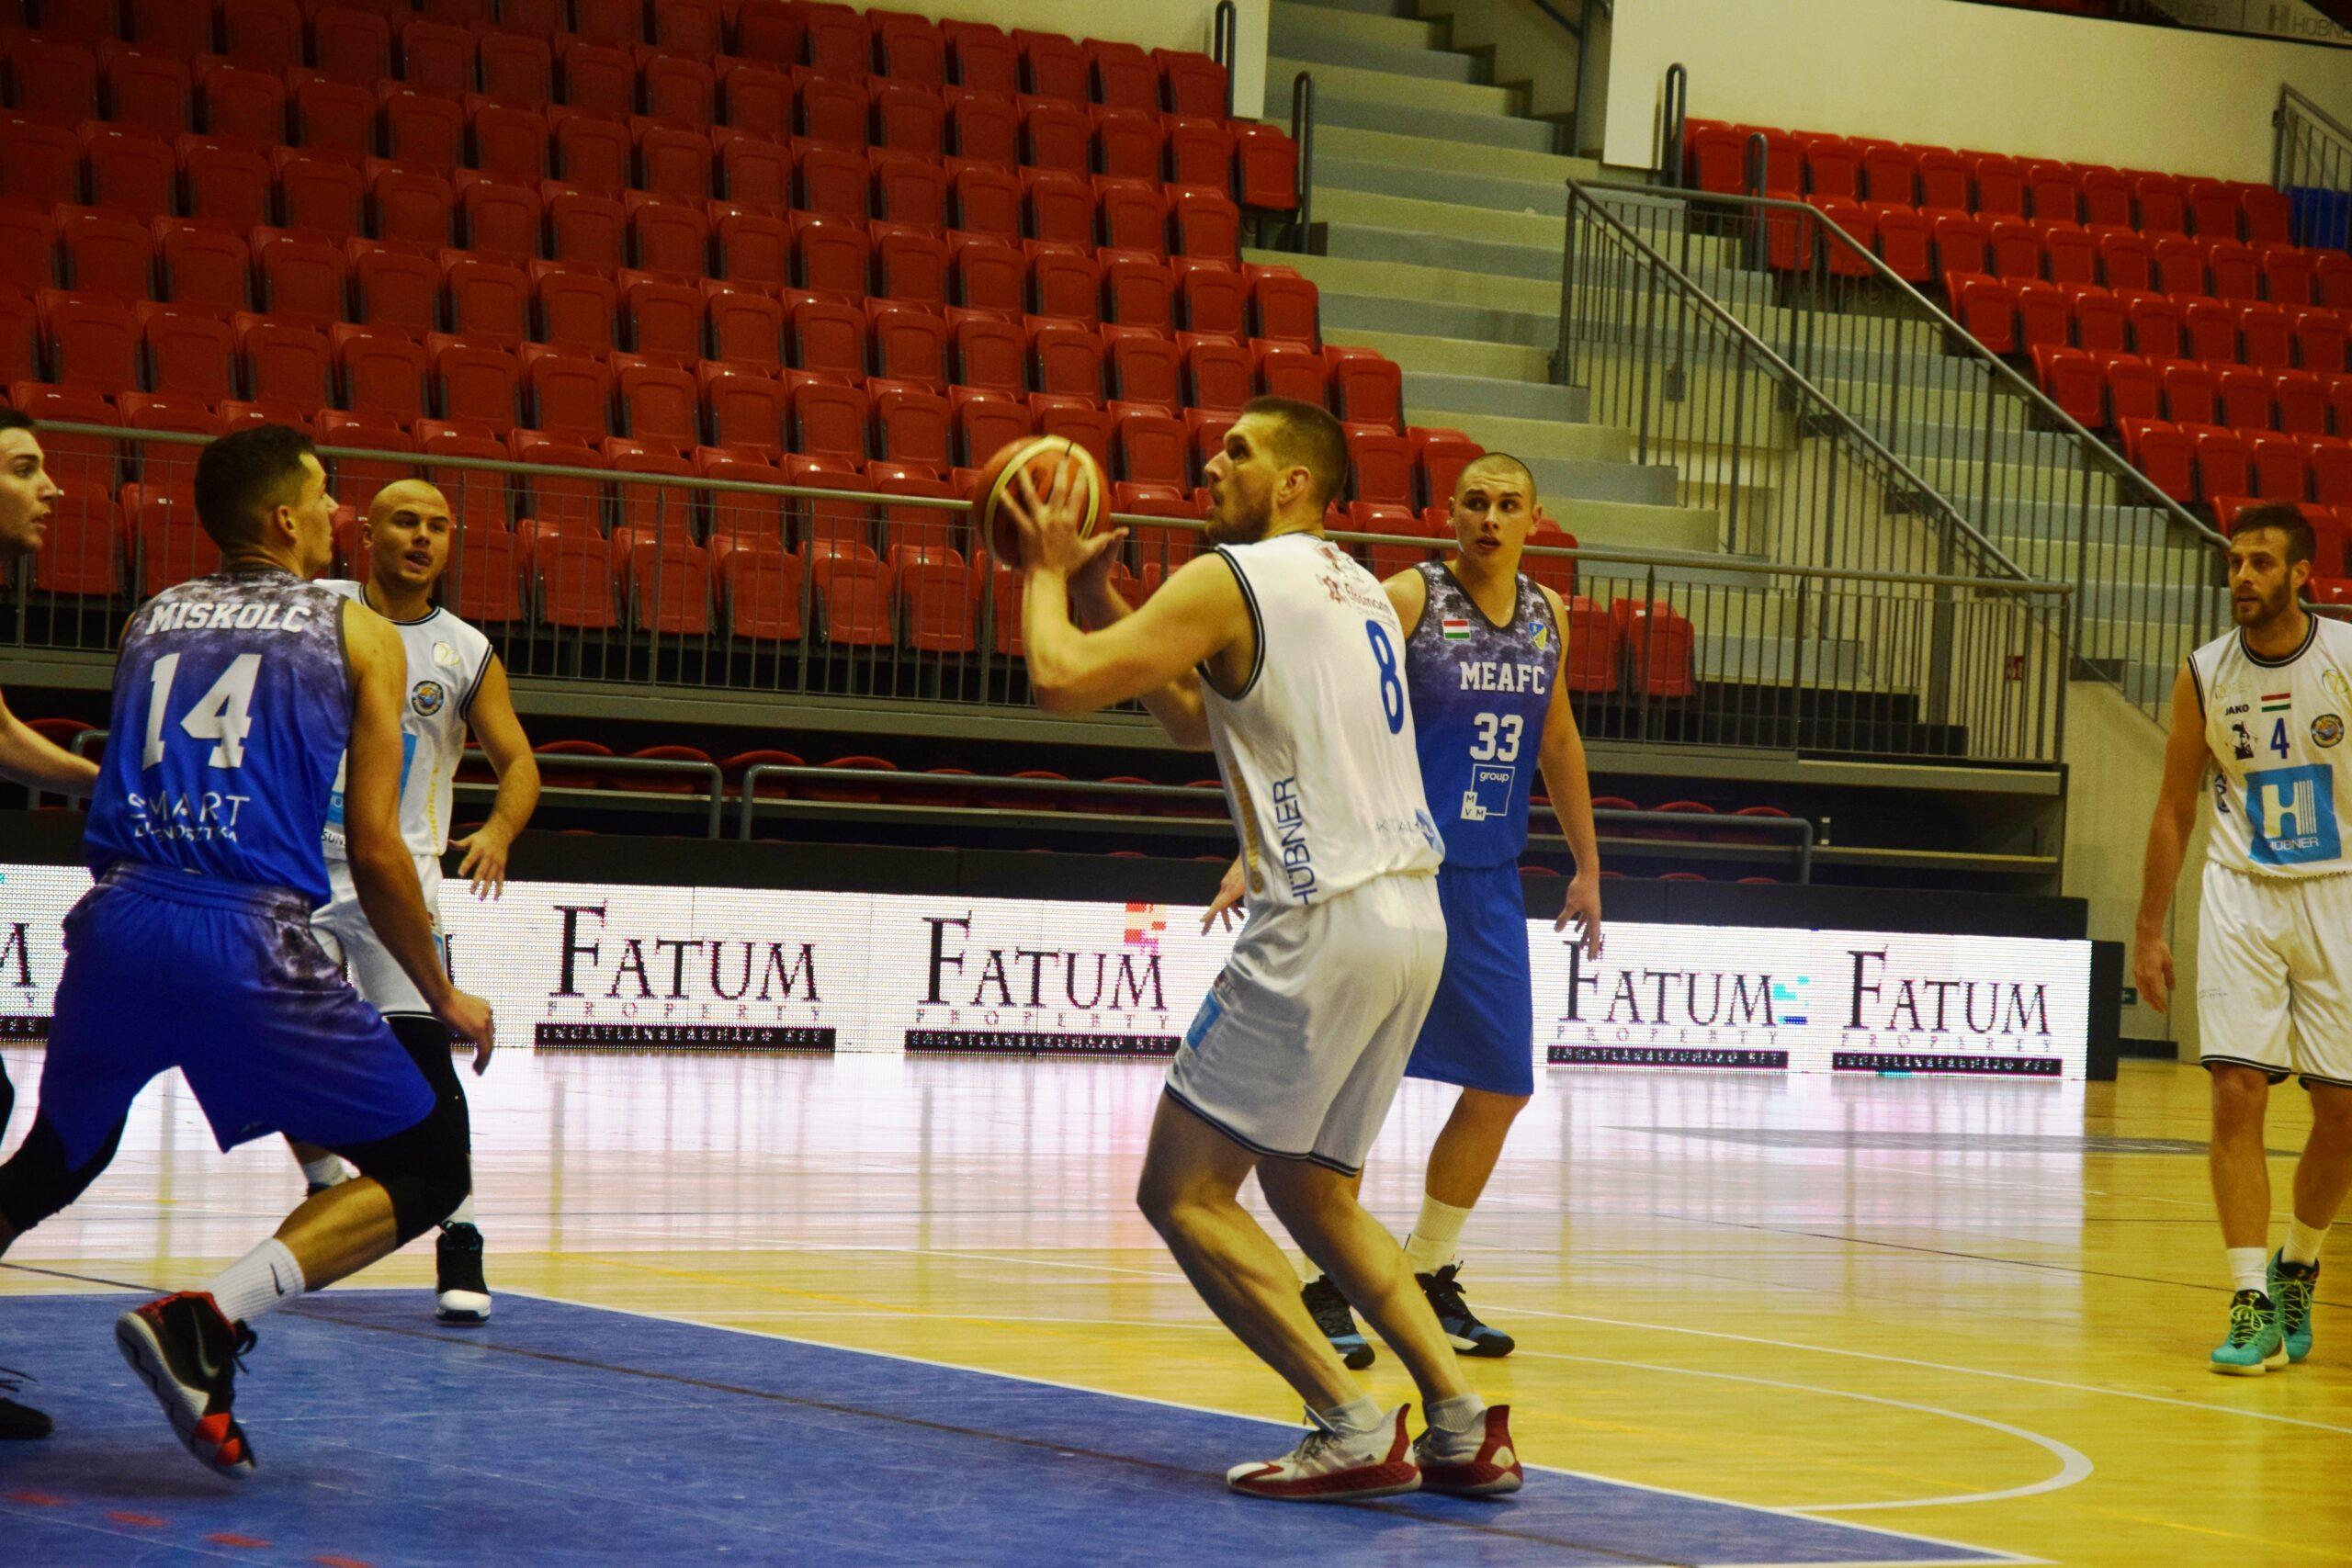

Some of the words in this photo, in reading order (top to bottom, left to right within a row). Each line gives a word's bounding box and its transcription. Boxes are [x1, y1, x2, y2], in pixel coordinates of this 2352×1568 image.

[144, 602, 311, 635] MISKOLC
[1365, 619, 1404, 735] 8
[1459, 661, 1545, 694] MEAFC
[142, 652, 262, 771] 14
[2224, 704, 2249, 716] JAKO
[1470, 712, 1523, 762] 33
[2270, 717, 2290, 759] 4
[1479, 771, 1510, 783] group
[128, 790, 251, 826] SMART
[548, 897, 822, 1002] FATUM
[917, 909, 1168, 1010] FATUM
[1557, 933, 1778, 1027] FATUM
[1842, 943, 2052, 1036] FATUM
[547, 1001, 821, 1021] PROPERTY
[915, 1009, 1170, 1030] PROPERTY
[1557, 1025, 1778, 1043] PROPERTY
